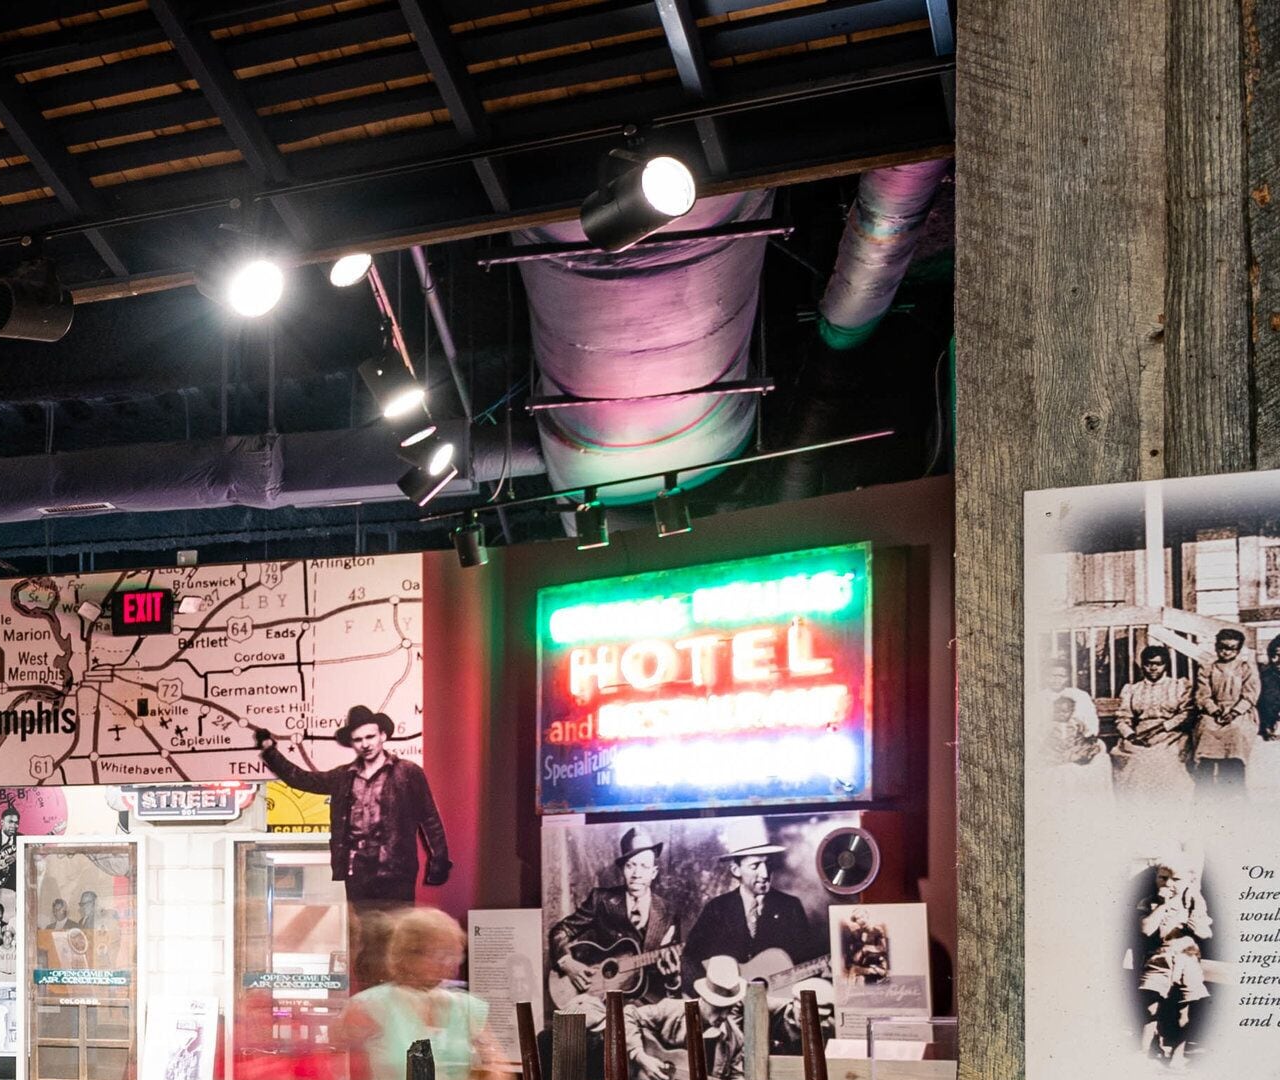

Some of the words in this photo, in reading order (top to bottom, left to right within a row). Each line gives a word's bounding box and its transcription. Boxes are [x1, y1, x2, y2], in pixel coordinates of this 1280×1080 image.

[265, 563, 278, 573] 70
[311, 557, 375, 569] Arlington
[173, 577, 236, 589] Brunswick
[265, 574, 278, 584] 79
[348, 587, 366, 601] 43
[123, 592, 164, 624] EXIT
[3, 629, 51, 642] Marion
[231, 623, 248, 638] 64
[266, 628, 297, 640] Eads
[178, 636, 228, 650] Bartlett
[18, 651, 48, 666] West
[234, 652, 286, 663] Cordova
[570, 617, 835, 698] HOTEL
[8, 667, 66, 684] Memphis
[162, 684, 179, 698] 72
[210, 684, 299, 697] Germantown
[149, 705, 189, 717] akville
[246, 703, 286, 715] Forest
[549, 713, 594, 744] and
[170, 735, 231, 748] Capleville
[34, 759, 49, 774] 61
[100, 761, 173, 775] Whitehaven
[596, 770, 611, 786] IN
[141, 789, 228, 809] STREET
[1240, 907, 1280, 922] woul
[1240, 928, 1280, 942] woul
[273, 981, 341, 989] CONDITIONED
[1239, 993, 1280, 1006] sittin
[1239, 1013, 1273, 1027] and
